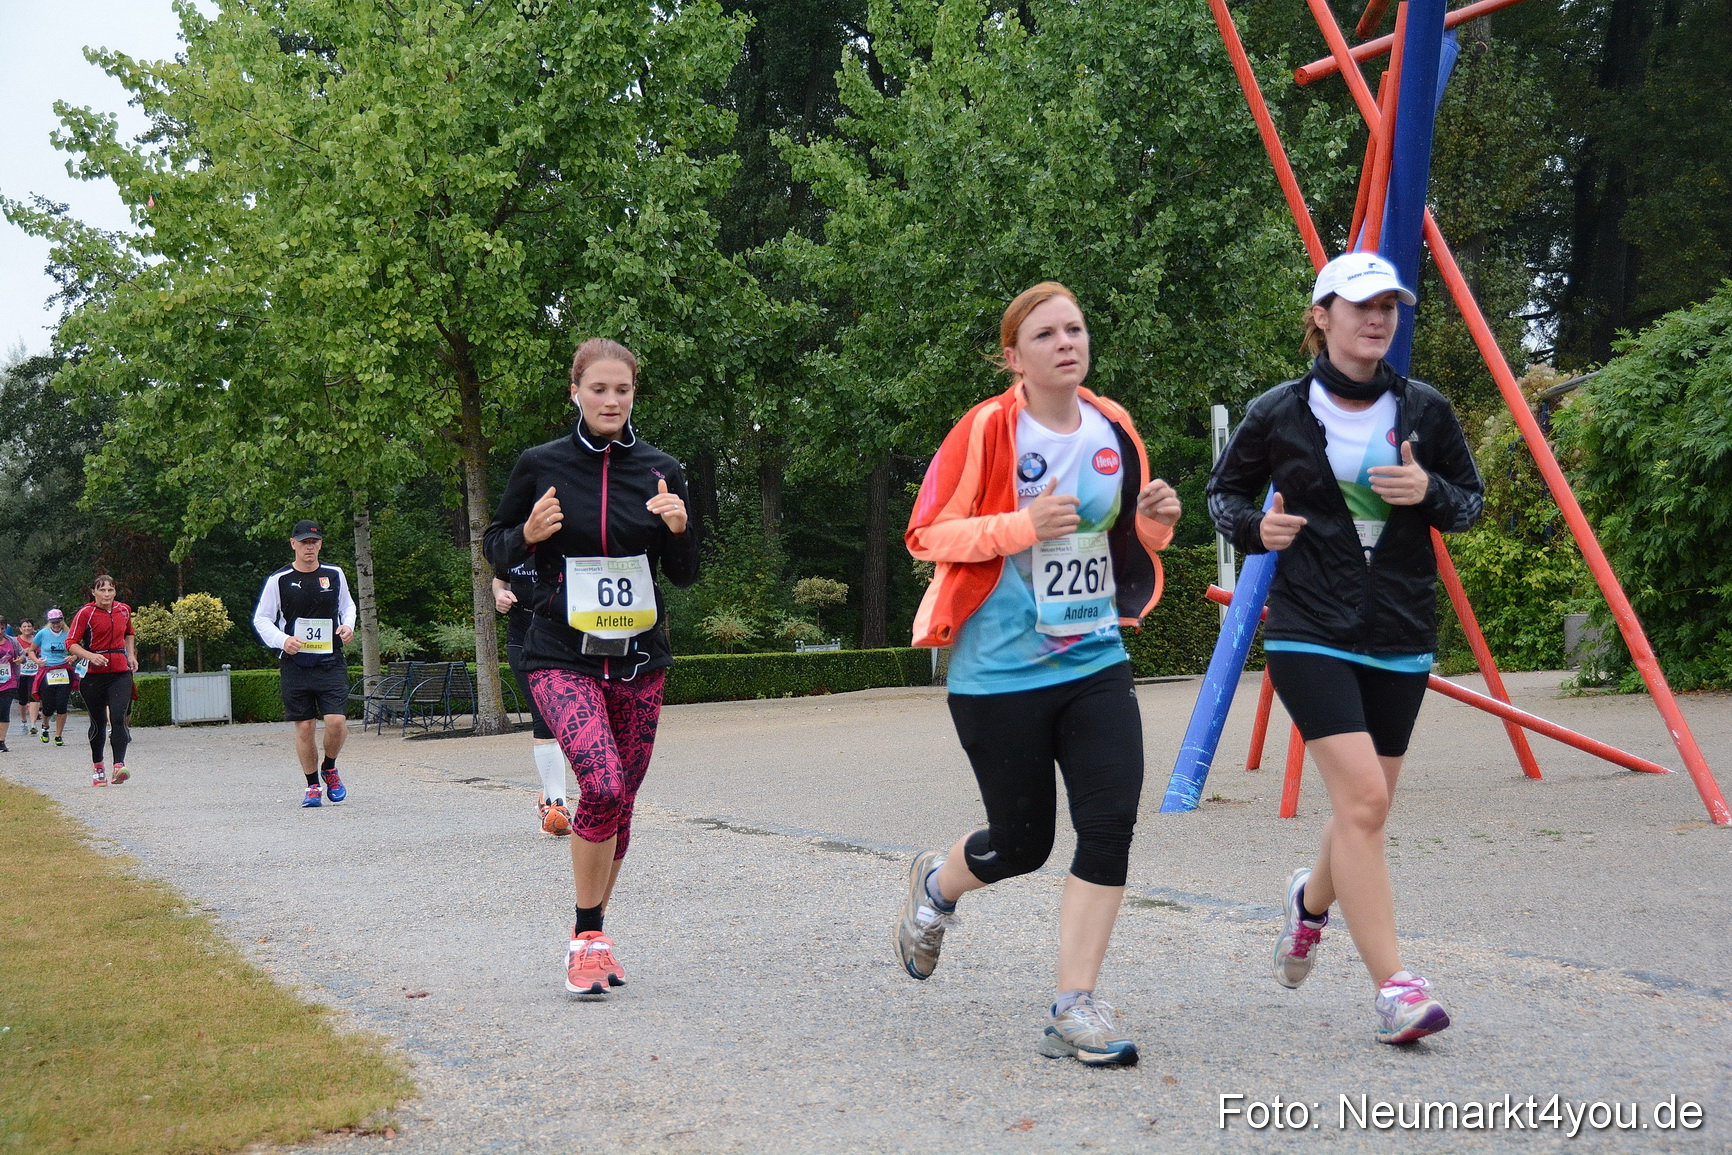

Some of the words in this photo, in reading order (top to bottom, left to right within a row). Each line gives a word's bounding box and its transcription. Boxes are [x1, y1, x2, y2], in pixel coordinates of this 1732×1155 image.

[1044, 555, 1109, 597] 2267
[597, 577, 634, 607] 68
[595, 615, 634, 627] Arlette
[1063, 605, 1099, 621] Andrea
[306, 627, 322, 641] 34
